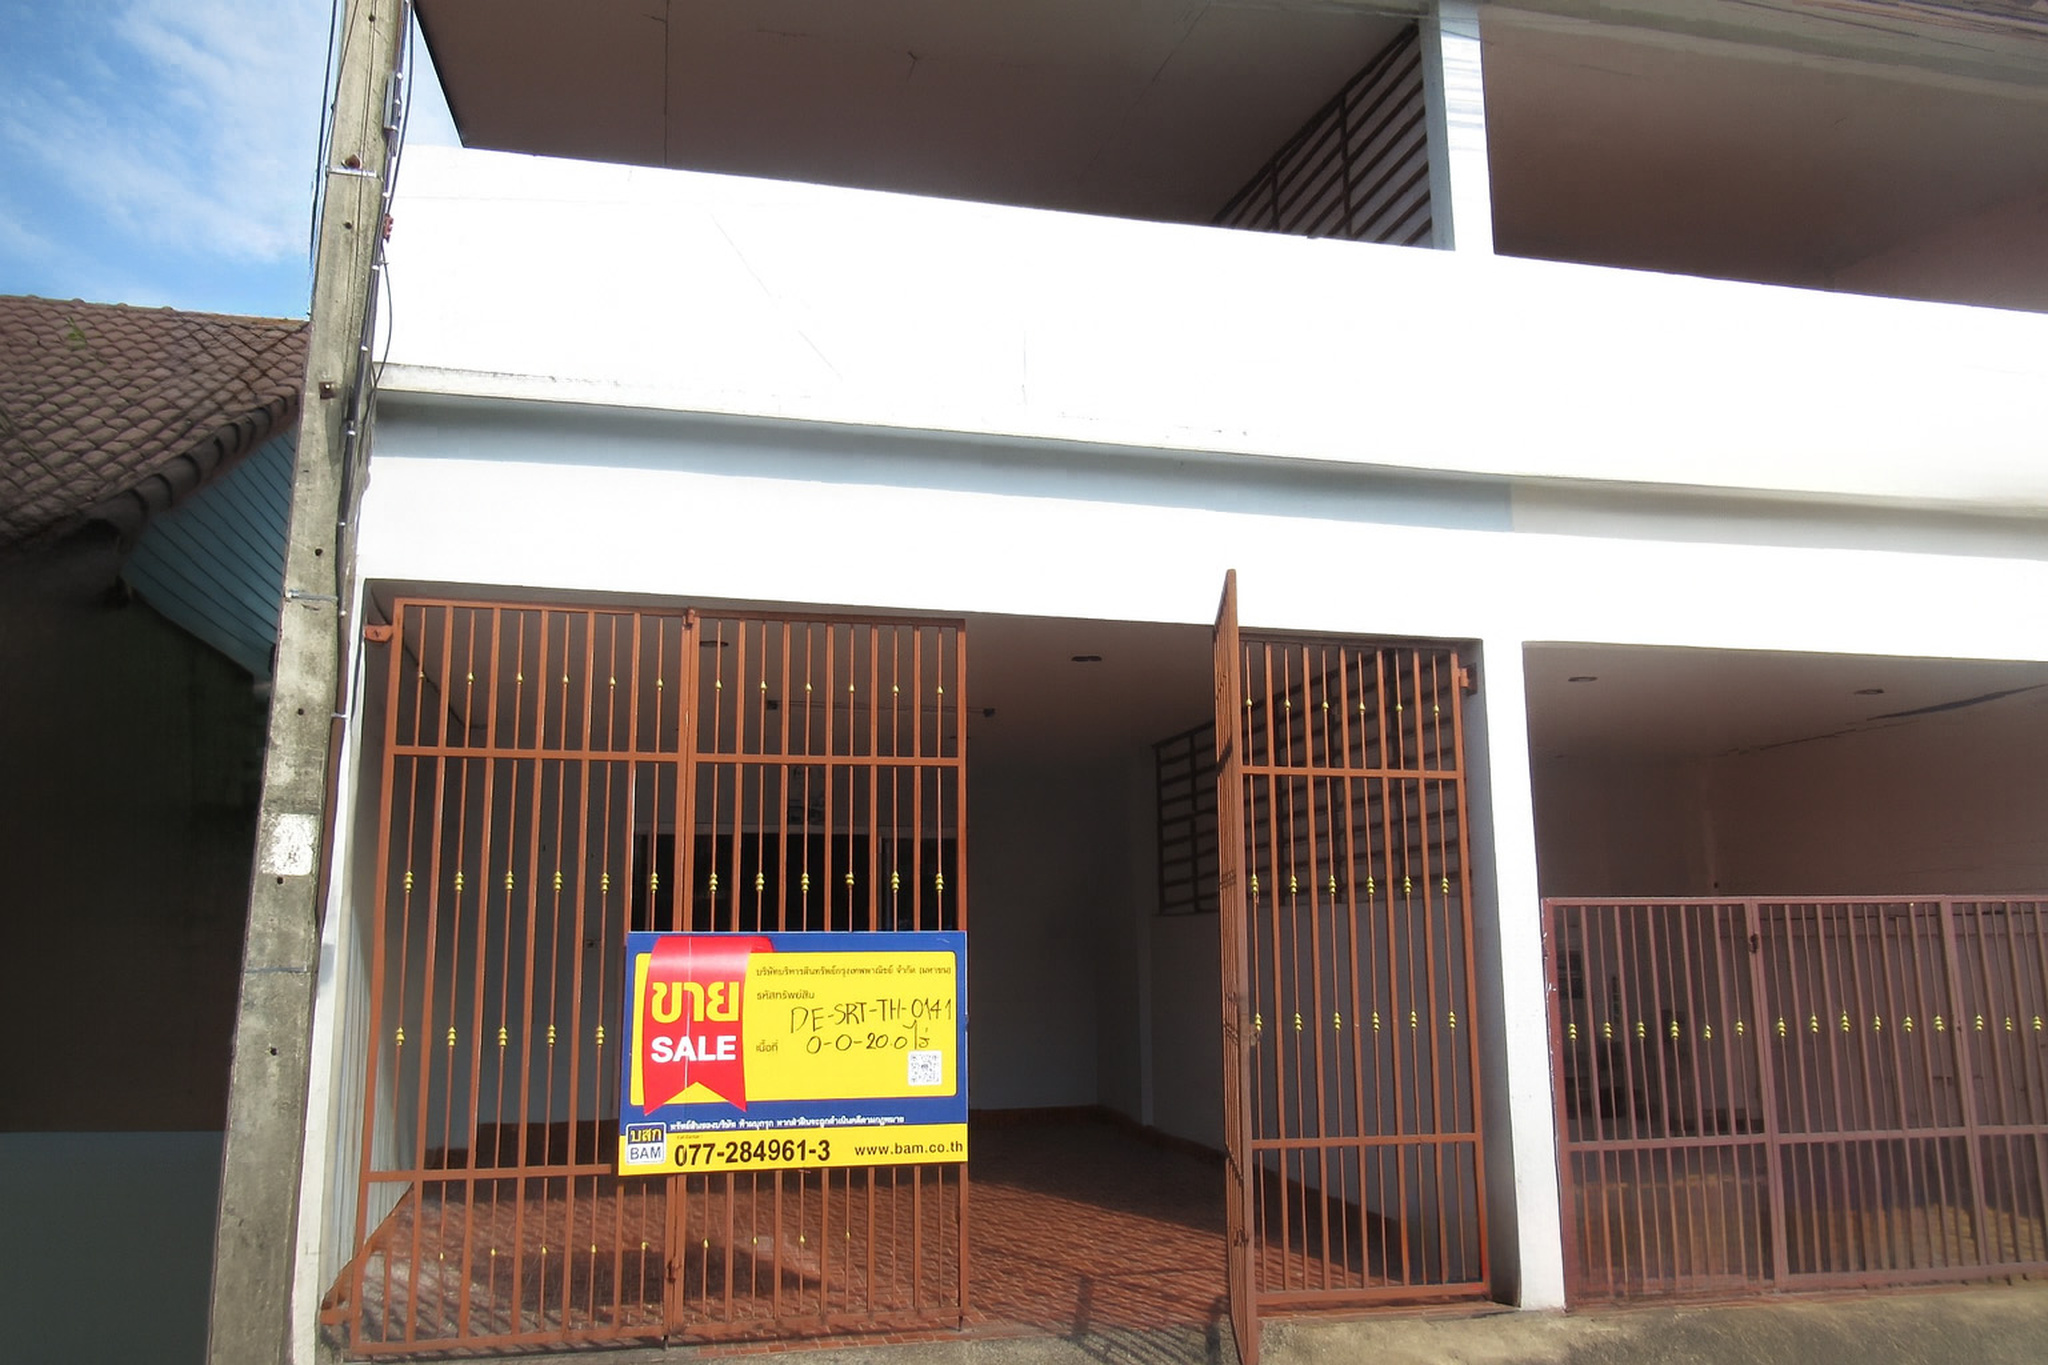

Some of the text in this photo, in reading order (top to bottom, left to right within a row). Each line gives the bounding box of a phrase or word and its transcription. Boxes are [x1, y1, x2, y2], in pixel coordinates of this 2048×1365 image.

[651, 981, 740, 1024] ขาย
[790, 997, 951, 1034] DE-SRT-TH-0141
[651, 1035, 737, 1063] SALE
[630, 1127, 662, 1142] บสก
[854, 1140, 964, 1156] www.bam.co.th
[630, 1146, 661, 1160] BAM
[674, 1138, 830, 1167] 077-284961-3
